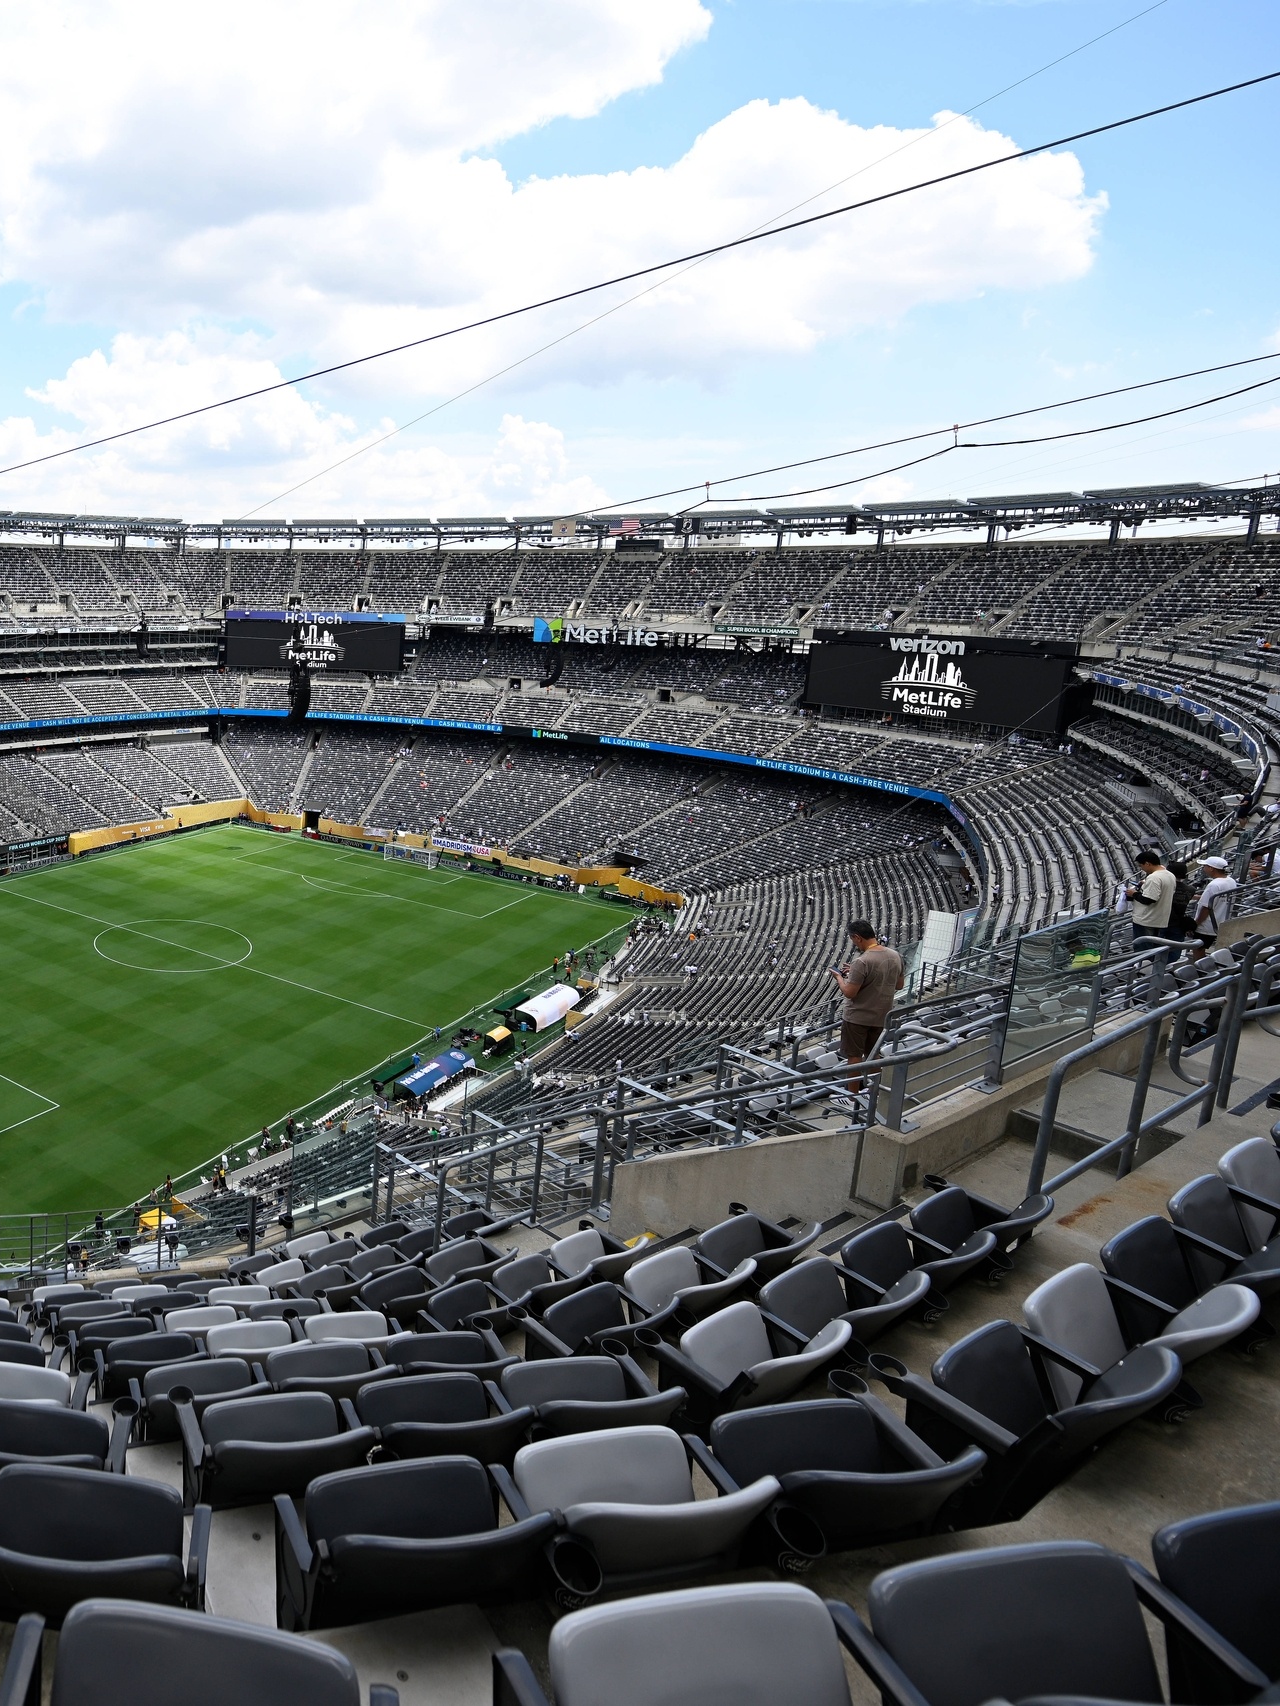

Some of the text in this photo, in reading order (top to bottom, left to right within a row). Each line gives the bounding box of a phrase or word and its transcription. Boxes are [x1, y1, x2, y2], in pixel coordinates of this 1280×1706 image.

[285, 612, 342, 624] HCLTech
[890, 635, 965, 655] verizon
[288, 650, 336, 661] MetLife
[893, 688, 962, 708] MetLife
[902, 704, 947, 717] Stadium
[542, 732, 568, 740] MetLife
[613, 739, 650, 748] LOCATIONS
[756, 759, 787, 771] METLIFE
[789, 765, 820, 776] STADIUM
[839, 773, 882, 789] CASH-FREE
[884, 783, 909, 794] VENUE
[320, 835, 339, 844] QATAR
[37, 856, 64, 869] AMERICA
[499, 871, 520, 881] ULTRA
